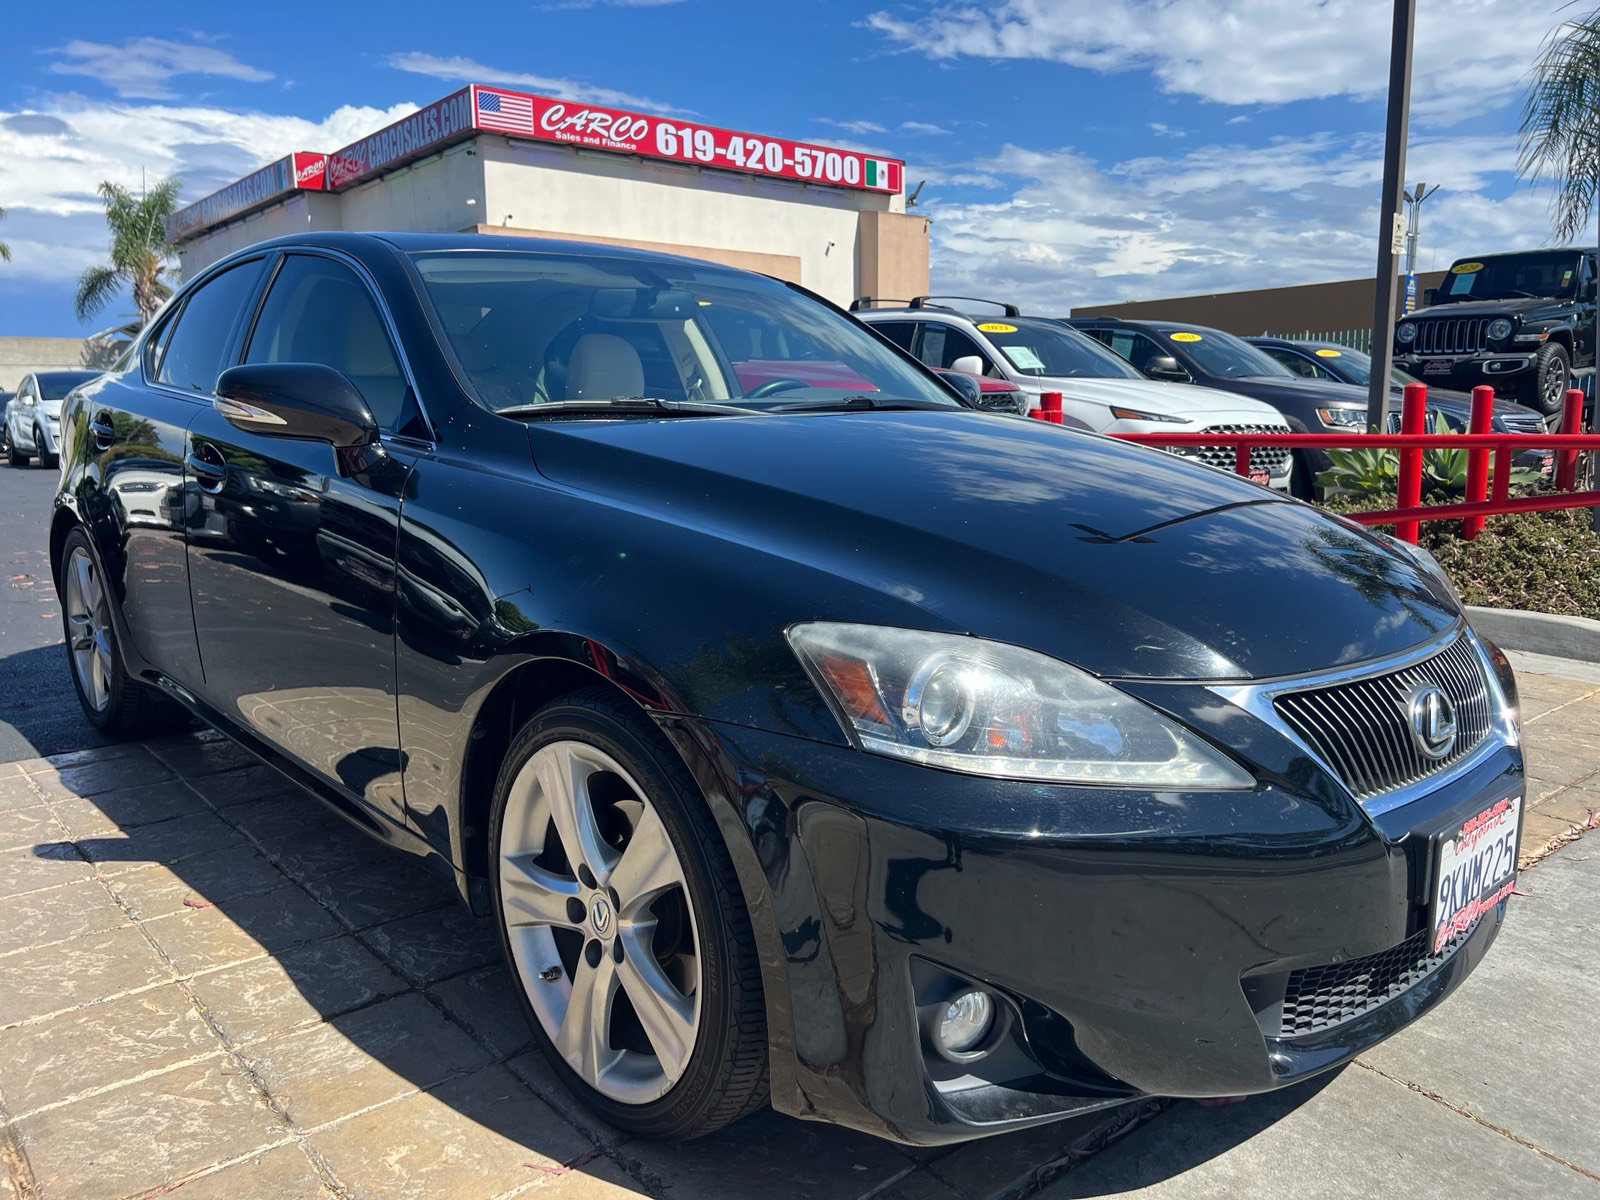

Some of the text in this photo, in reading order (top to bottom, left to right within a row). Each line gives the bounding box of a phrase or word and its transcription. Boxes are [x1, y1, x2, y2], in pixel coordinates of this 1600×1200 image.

[368, 91, 472, 169] CARCOSALES.COM
[541, 104, 649, 142] CARCO
[555, 131, 637, 151] Sales and Finance
[296, 160, 325, 181] CARCO
[655, 122, 861, 184] 619-420-5700
[1435, 828, 1515, 929] 9KWM225
